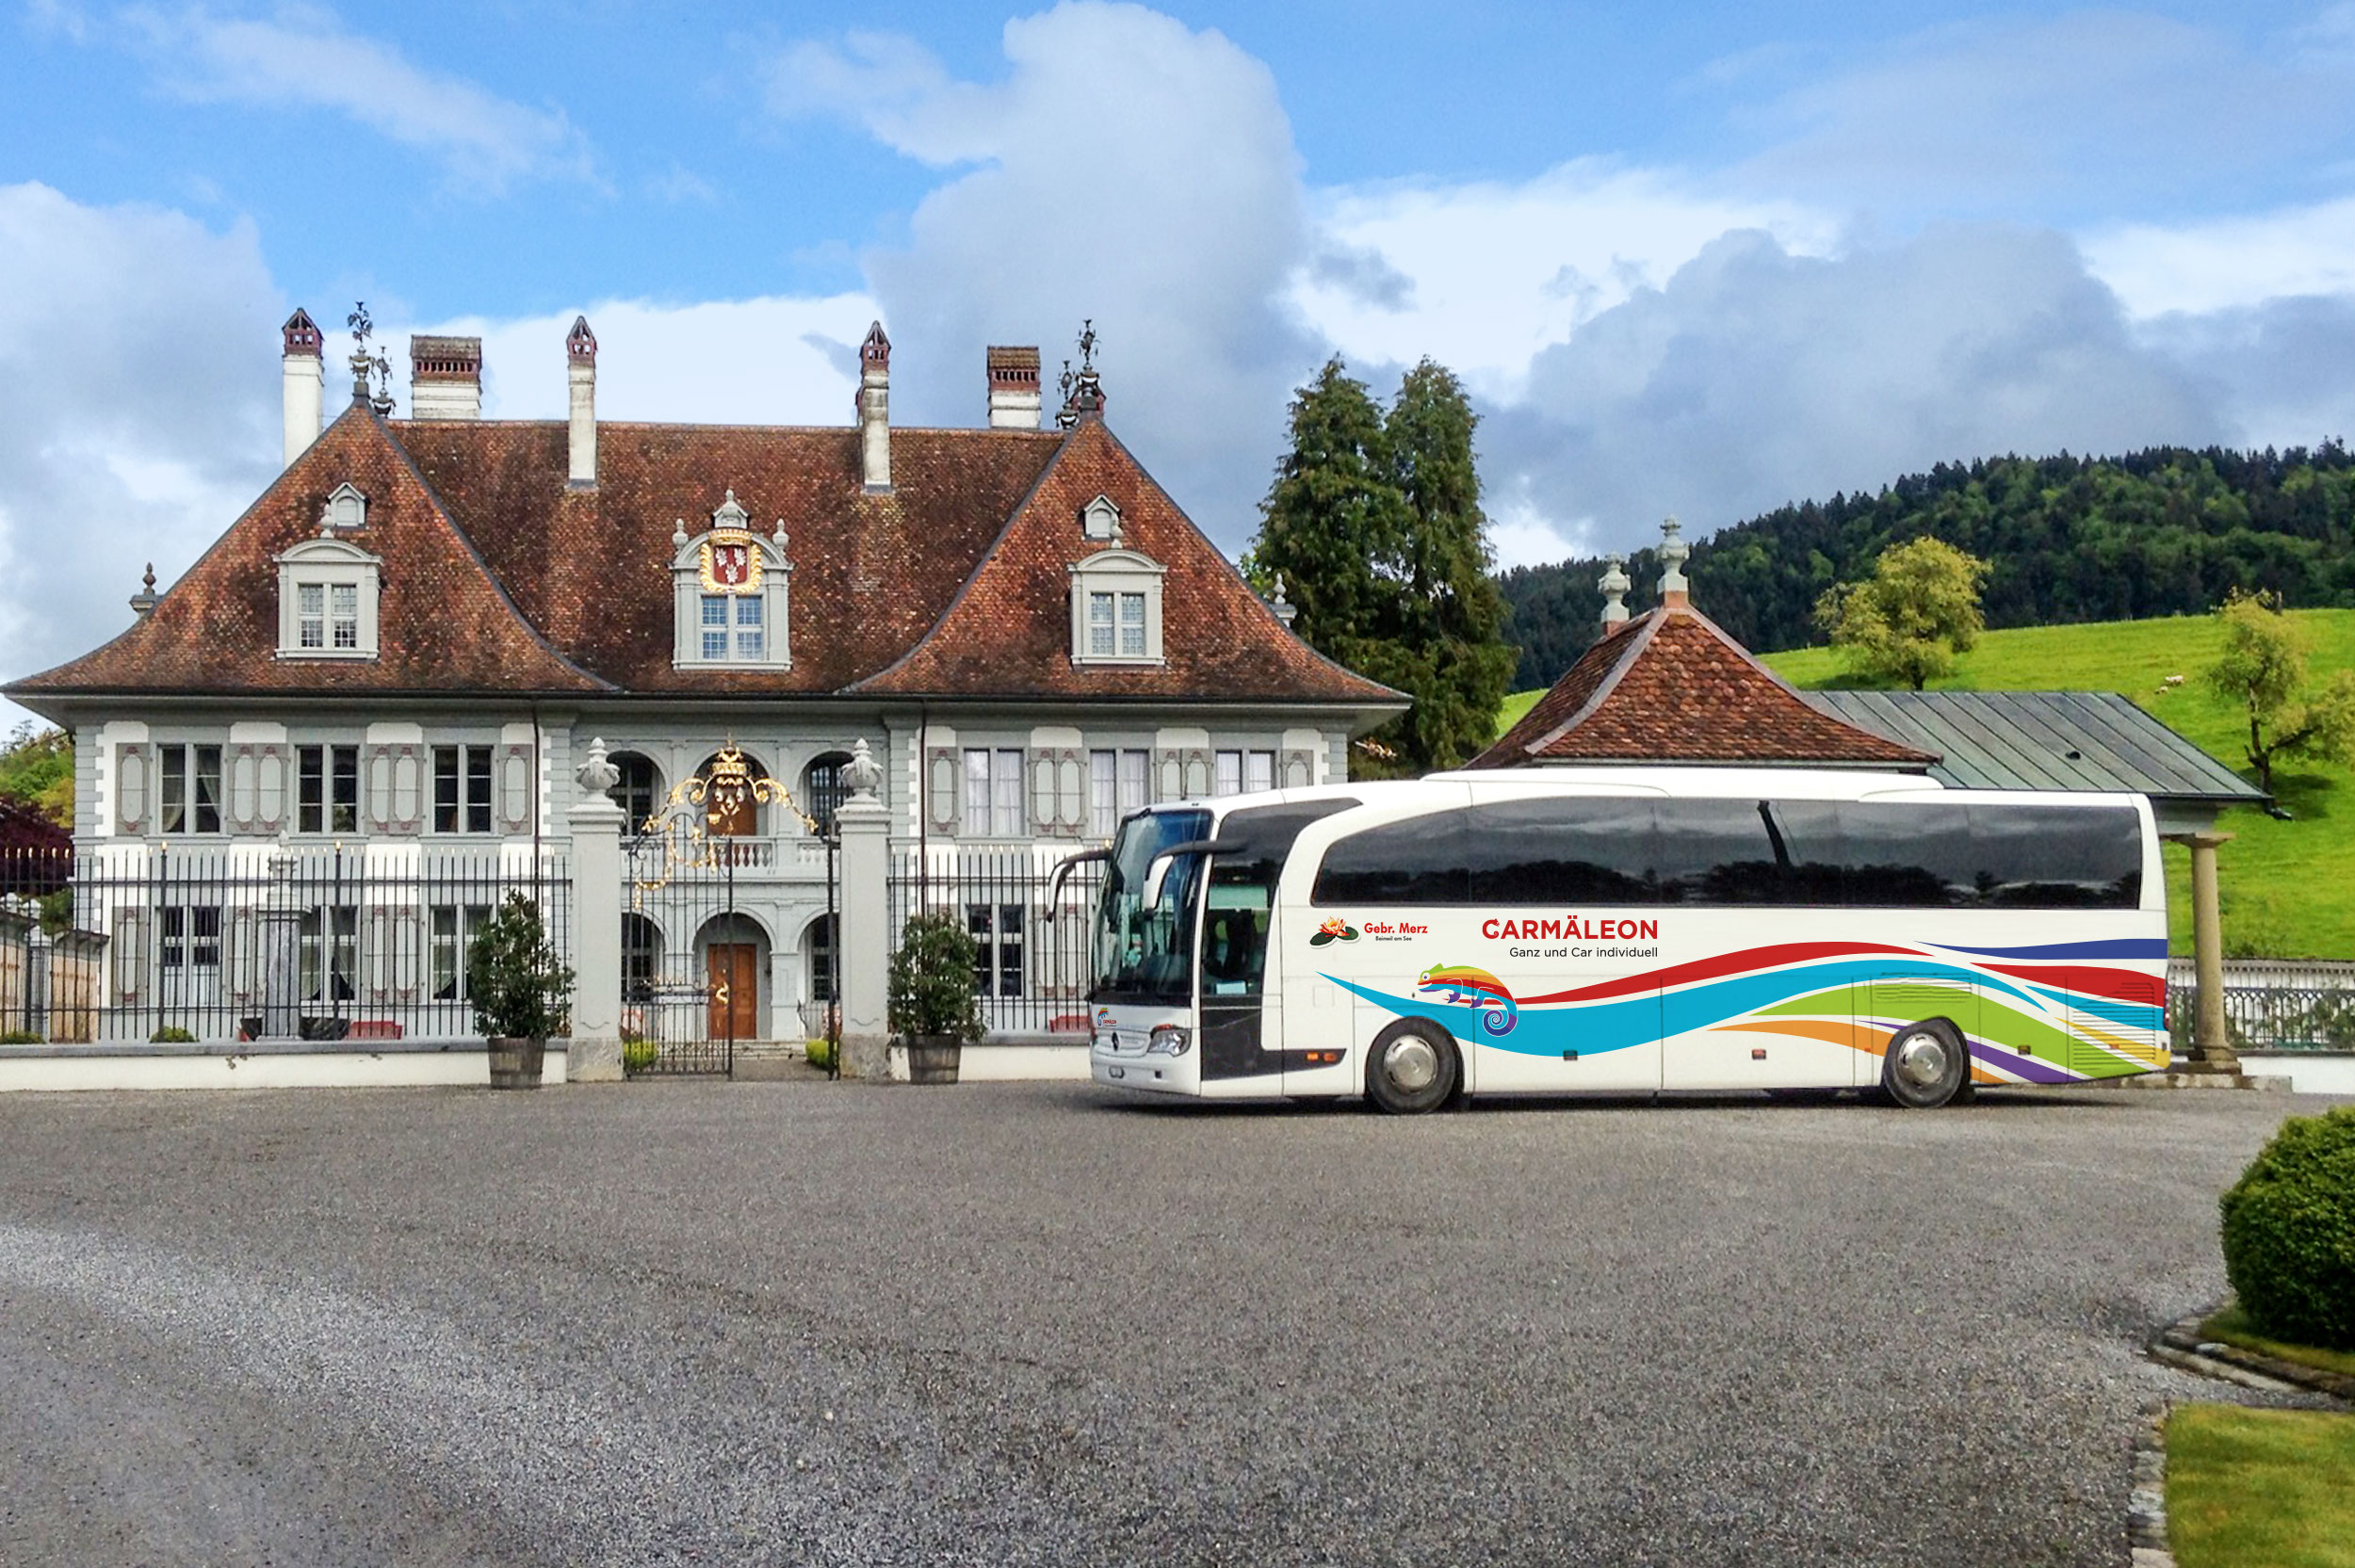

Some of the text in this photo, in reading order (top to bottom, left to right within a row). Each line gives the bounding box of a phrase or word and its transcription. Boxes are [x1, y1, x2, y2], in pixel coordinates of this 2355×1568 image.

[1363, 921, 1429, 934] Gebr. Merz
[1482, 914, 1658, 940] CARMÄLEON
[1509, 946, 1658, 958] Ganz und Car individuell
